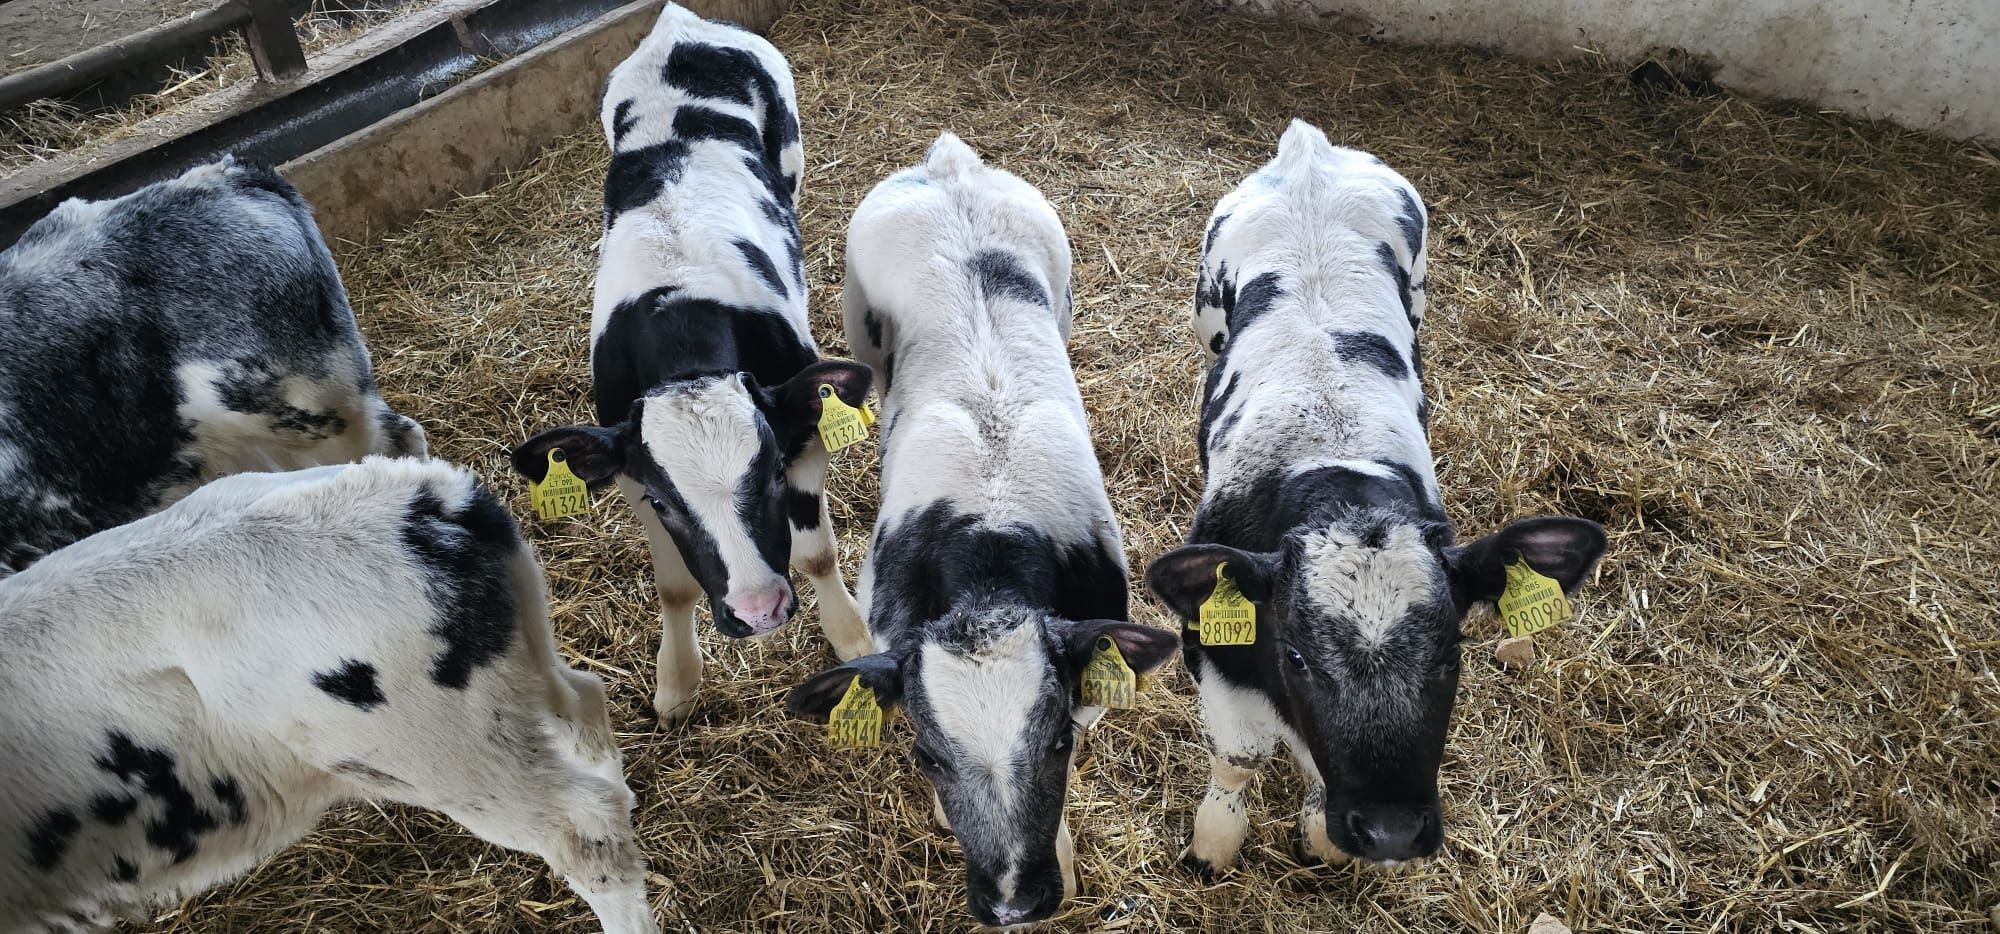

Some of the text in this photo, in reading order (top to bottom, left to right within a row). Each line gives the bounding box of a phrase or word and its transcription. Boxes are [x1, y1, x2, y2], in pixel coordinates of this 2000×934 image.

[825, 421, 866, 450] 11324
[541, 494, 587, 518] 11324
[1509, 581, 1540, 599] LT 085
[1508, 598, 1569, 637] 98092
[1204, 621, 1253, 644] 98092
[1084, 680, 1131, 707] 33141
[830, 719, 877, 746] 33141
